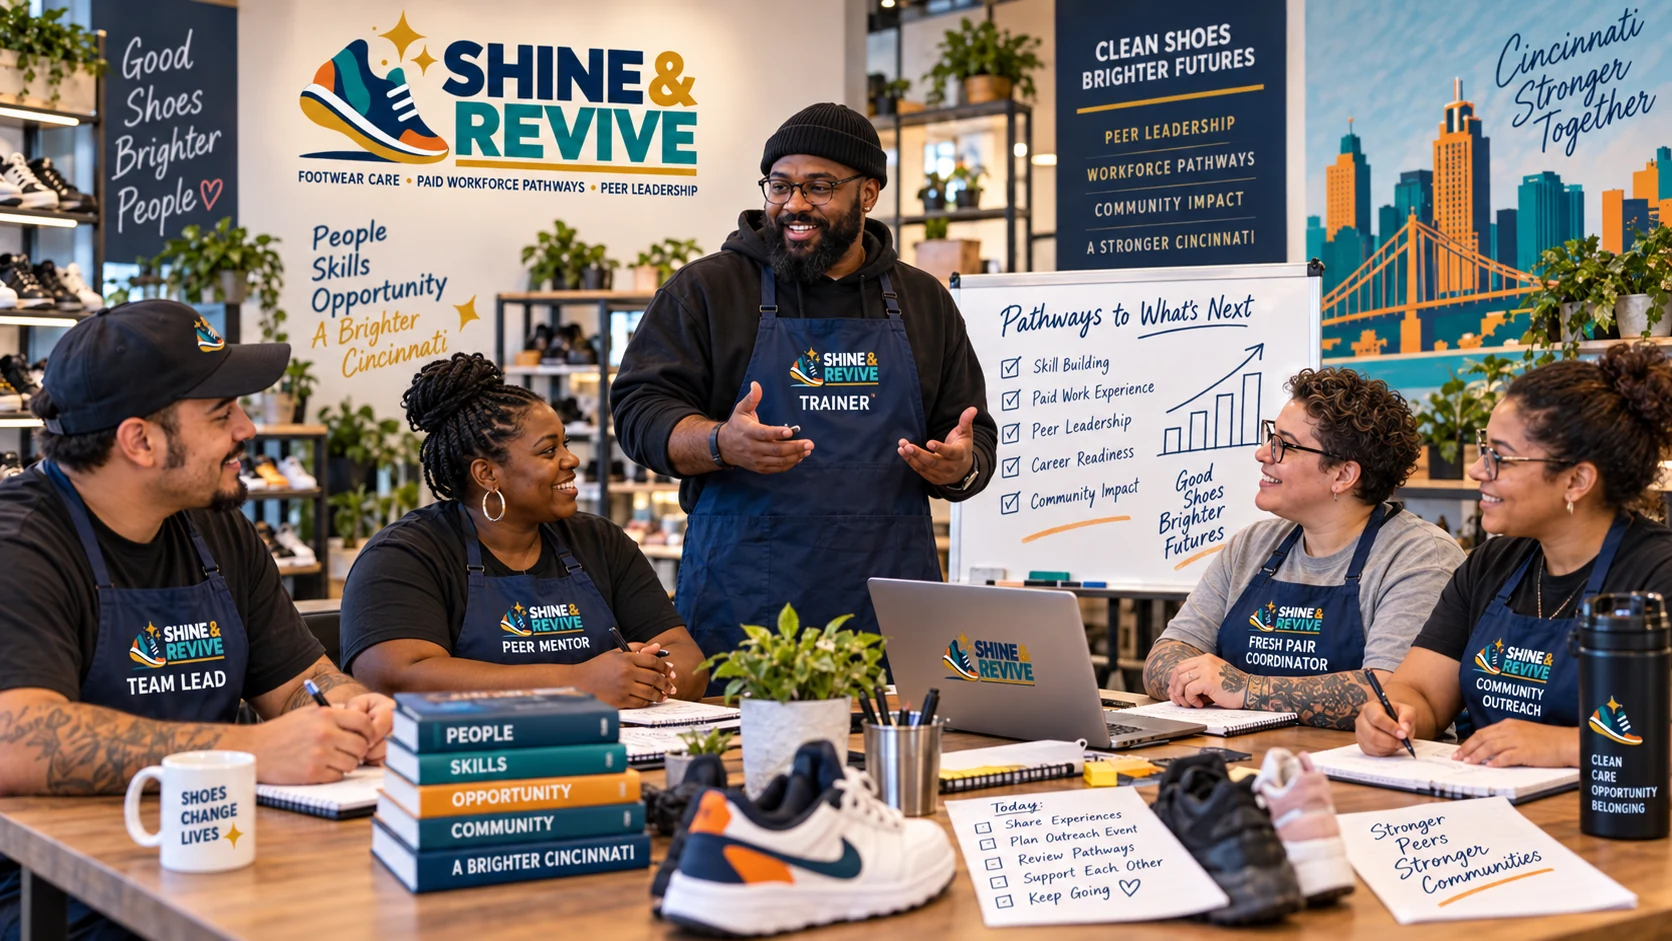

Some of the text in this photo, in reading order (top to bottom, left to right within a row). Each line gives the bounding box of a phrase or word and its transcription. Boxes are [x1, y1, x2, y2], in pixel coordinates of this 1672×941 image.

[122, 28, 194, 80] Good
[1095, 23, 1231, 62] CLEAN SHOES
[1496, 8, 1644, 88] Cincinnati
[1082, 47, 1255, 90] BRIGHTER FUTURES
[1512, 58, 1632, 127] Stronger
[124, 85, 203, 127] Shoes
[455, 101, 697, 165] REVIVE
[1105, 115, 1235, 144] PEER LEADERSHIP
[1533, 88, 1656, 157] Together
[111, 127, 222, 181] Brighter
[1087, 151, 1255, 182] WORKFORCE PATHWAYS
[298, 170, 698, 197] FOOTWEAR CARE PAID WORKFORCE PATHWAYS PEER LEADERSHIP
[117, 177, 197, 237] People
[1095, 191, 1244, 217] COMMUNITY IMPACT
[313, 219, 387, 251] People
[1087, 230, 1255, 255] A STRONGER CINCINNATI
[312, 253, 370, 281] Skills
[312, 273, 447, 318] Opportunity
[1000, 303, 1102, 338] Pathways
[1113, 303, 1130, 327] to
[1207, 294, 1255, 321] Next
[312, 310, 420, 348] A Brighter
[342, 329, 448, 378] Cincinnati
[1033, 356, 1110, 375] Skill Building
[824, 367, 879, 381] REVIVE
[799, 395, 870, 411] TRAINER
[1032, 382, 1155, 407] Paid Work Experience
[1032, 414, 1132, 439] Peer Leadership
[1031, 446, 1135, 473] Career Readiness
[1175, 462, 1214, 492] Good
[1030, 477, 1140, 510] Community Impact
[1183, 485, 1224, 509] Shoes
[1159, 503, 1225, 535] Brighter
[1164, 526, 1224, 559] Futures
[531, 616, 583, 632] REVIVE
[1275, 617, 1322, 631] REVIVE
[166, 637, 224, 660] REVIVE
[502, 637, 591, 653] PEER MENTOR
[1249, 636, 1316, 653] FRESH PAIR
[978, 659, 1035, 681] REVIVE
[1246, 652, 1328, 671] COORDINATOR
[1502, 659, 1551, 680] REVIVE
[126, 670, 227, 695] TEAM LEAD
[1476, 677, 1545, 701] COMMUNITY
[1482, 694, 1541, 717] OUTREACH
[446, 724, 514, 744] PEOPLE
[450, 757, 507, 775] SKILLS
[1591, 754, 1622, 768] CLEAN
[1591, 769, 1616, 783] CARE
[181, 785, 227, 806] SHOES
[452, 784, 572, 808] OPPORTUNITY
[1591, 785, 1658, 799] OPPORTUNITY
[181, 803, 238, 825] CHANGE
[991, 801, 1043, 814] Today:
[1591, 800, 1645, 814] BELONGING
[451, 815, 555, 839] COMMUNITY
[1005, 811, 1122, 830] Share Experiences
[1370, 814, 1446, 841] Stronger
[181, 826, 219, 845] LIVES
[1010, 824, 1138, 847] Plan Outreach Event
[1395, 834, 1449, 855] Peers
[452, 845, 635, 877] A BRIGHTER CINCINNATI
[1018, 842, 1135, 866] Review Pathways
[1394, 844, 1490, 880] Stronger
[1023, 858, 1164, 885] Support Each Other
[1422, 850, 1542, 894] Communities
[1028, 884, 1110, 905] Keep Going
